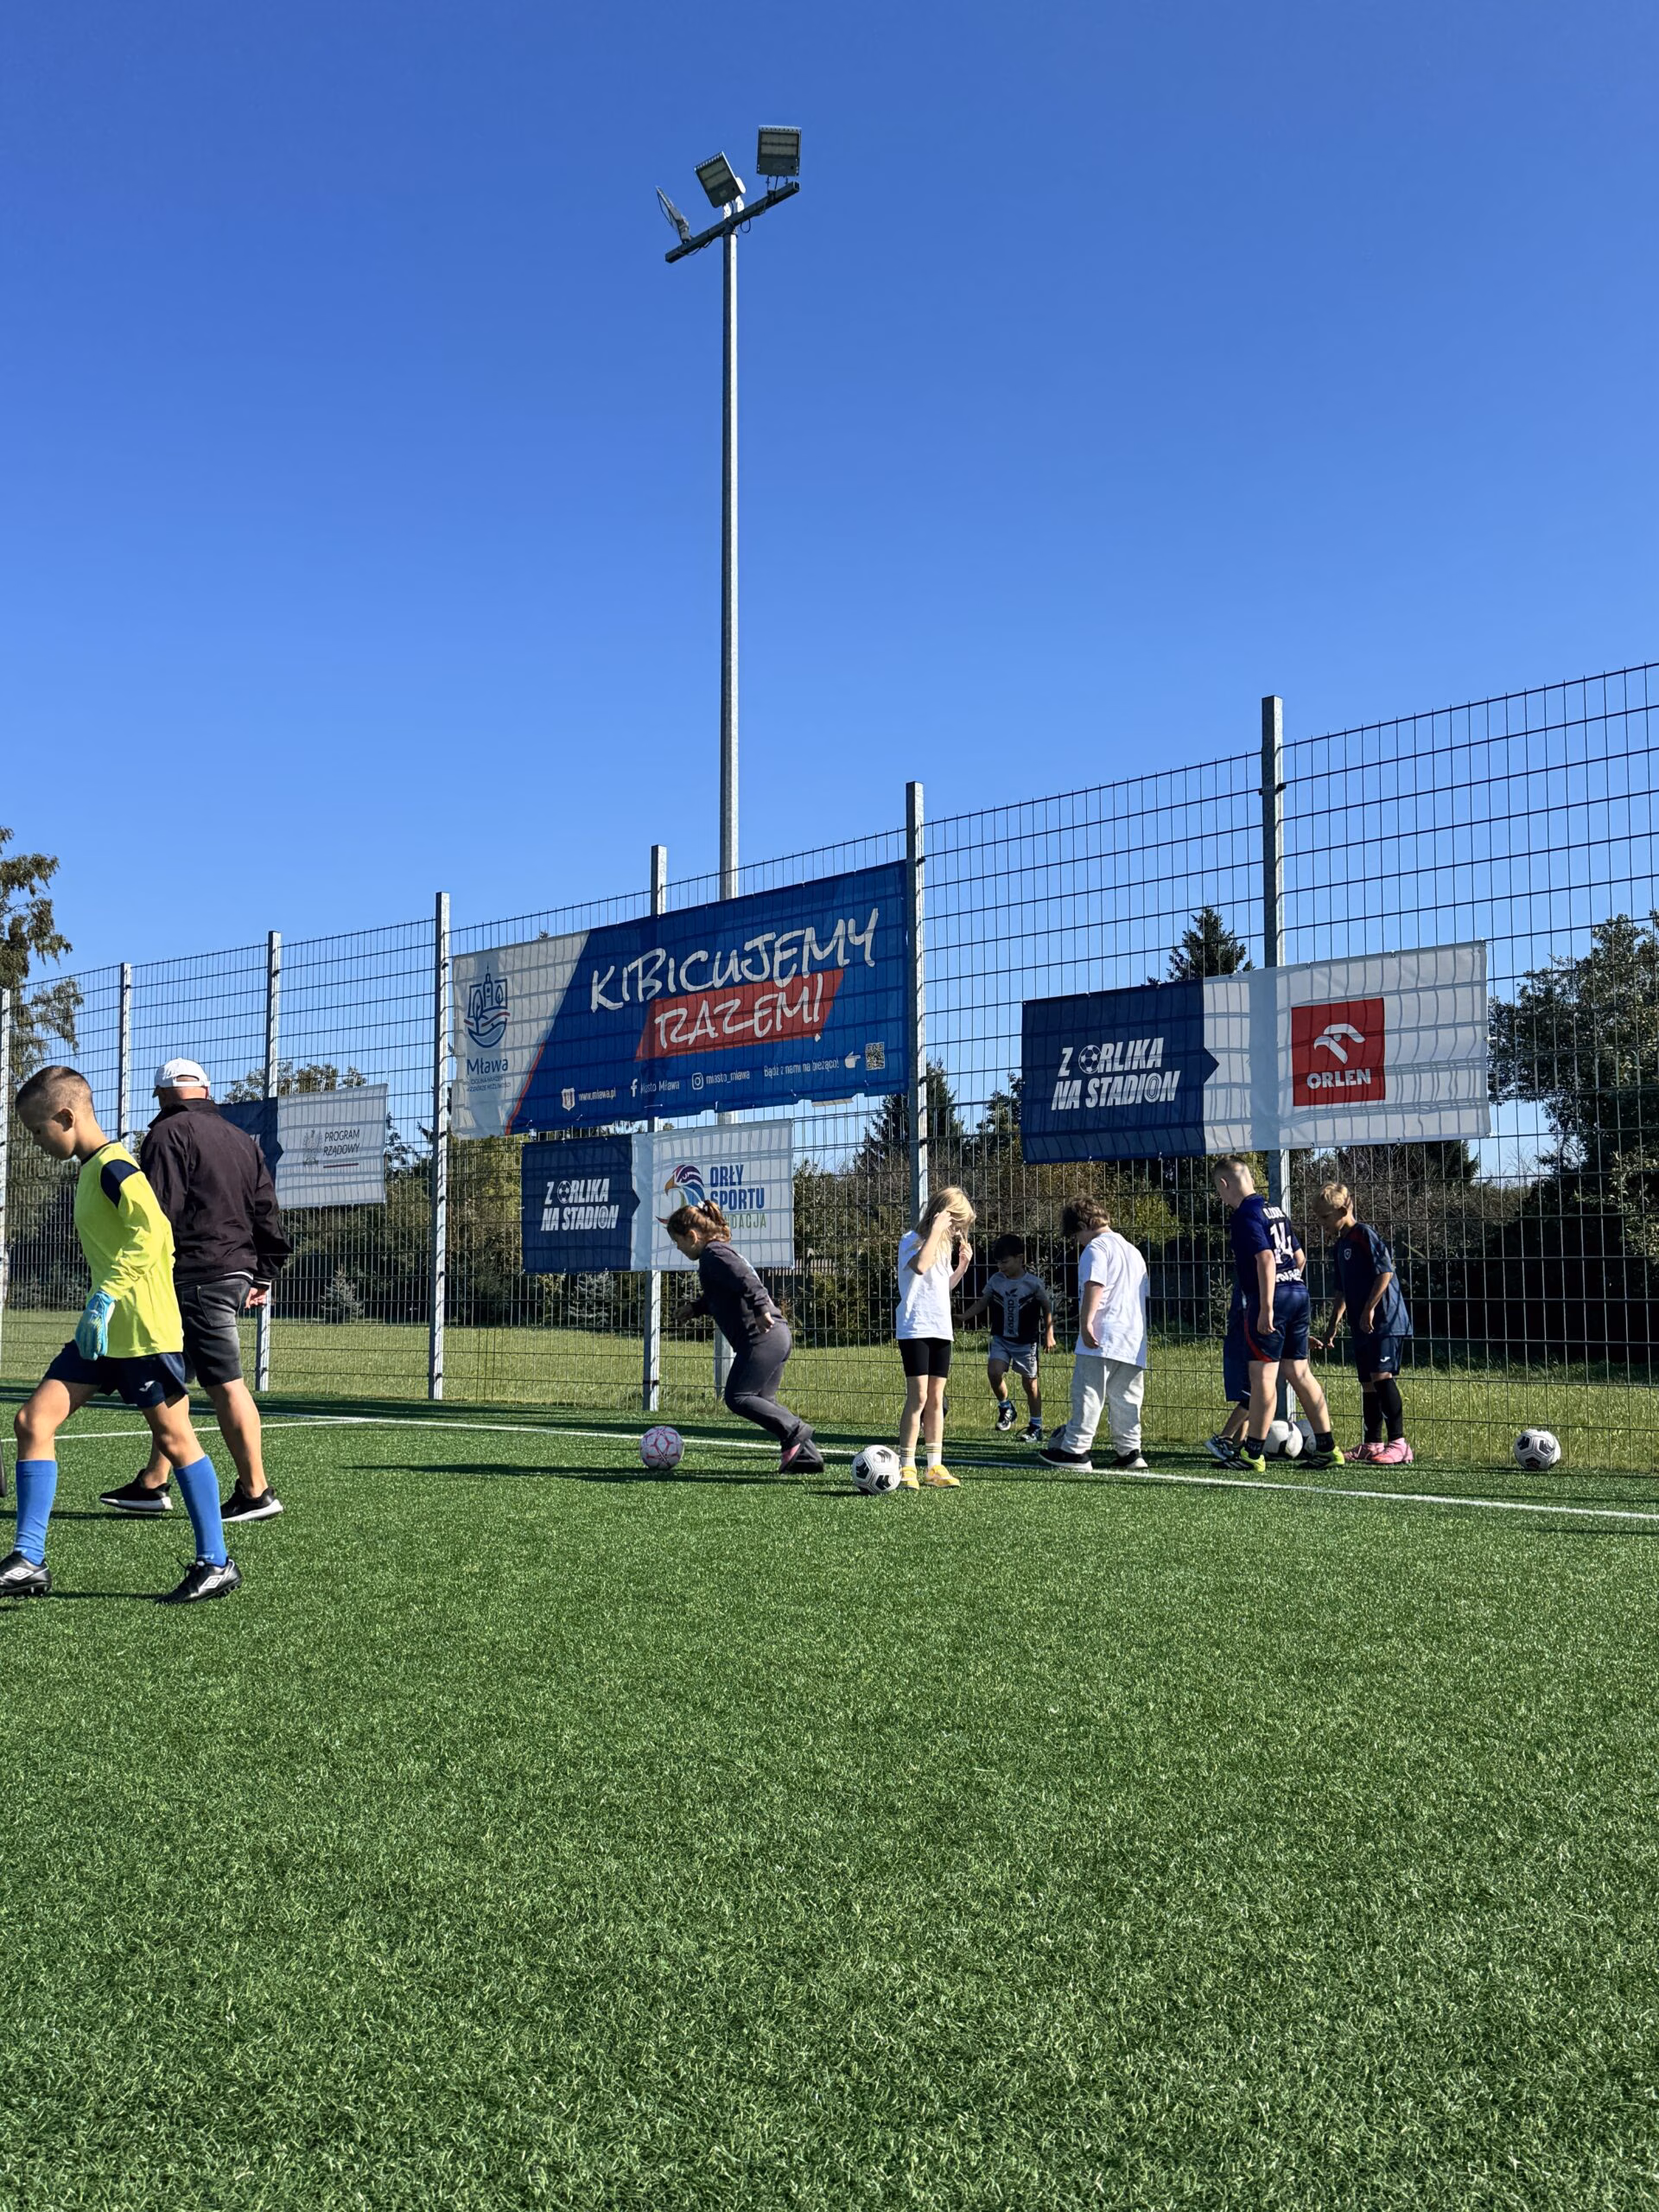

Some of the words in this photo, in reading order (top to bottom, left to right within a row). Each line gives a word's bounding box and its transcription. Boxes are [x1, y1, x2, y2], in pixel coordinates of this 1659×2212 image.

[590, 908, 879, 1013] KIBICUJEMY
[654, 973, 823, 1049] RAZEM!
[467, 1058, 508, 1075] Mława
[785, 1064, 802, 1074] nami
[802, 1063, 810, 1073] na
[1058, 1046, 1073, 1077] Z
[658, 1079, 680, 1093] Mława
[1051, 1079, 1082, 1110] NA
[1084, 1070, 1181, 1109] STADION
[1306, 1067, 1372, 1090] ORLEN
[324, 1128, 360, 1142] PROGRAM
[323, 1143, 360, 1157] RZĄDOWY
[709, 1164, 745, 1188] ORŁY
[543, 1181, 554, 1205] Z
[709, 1187, 765, 1211] SPORTU
[540, 1208, 561, 1232] NA
[561, 1205, 620, 1231] STADION
[725, 1212, 767, 1230] NDACJA
[1269, 1222, 1294, 1264] 14
